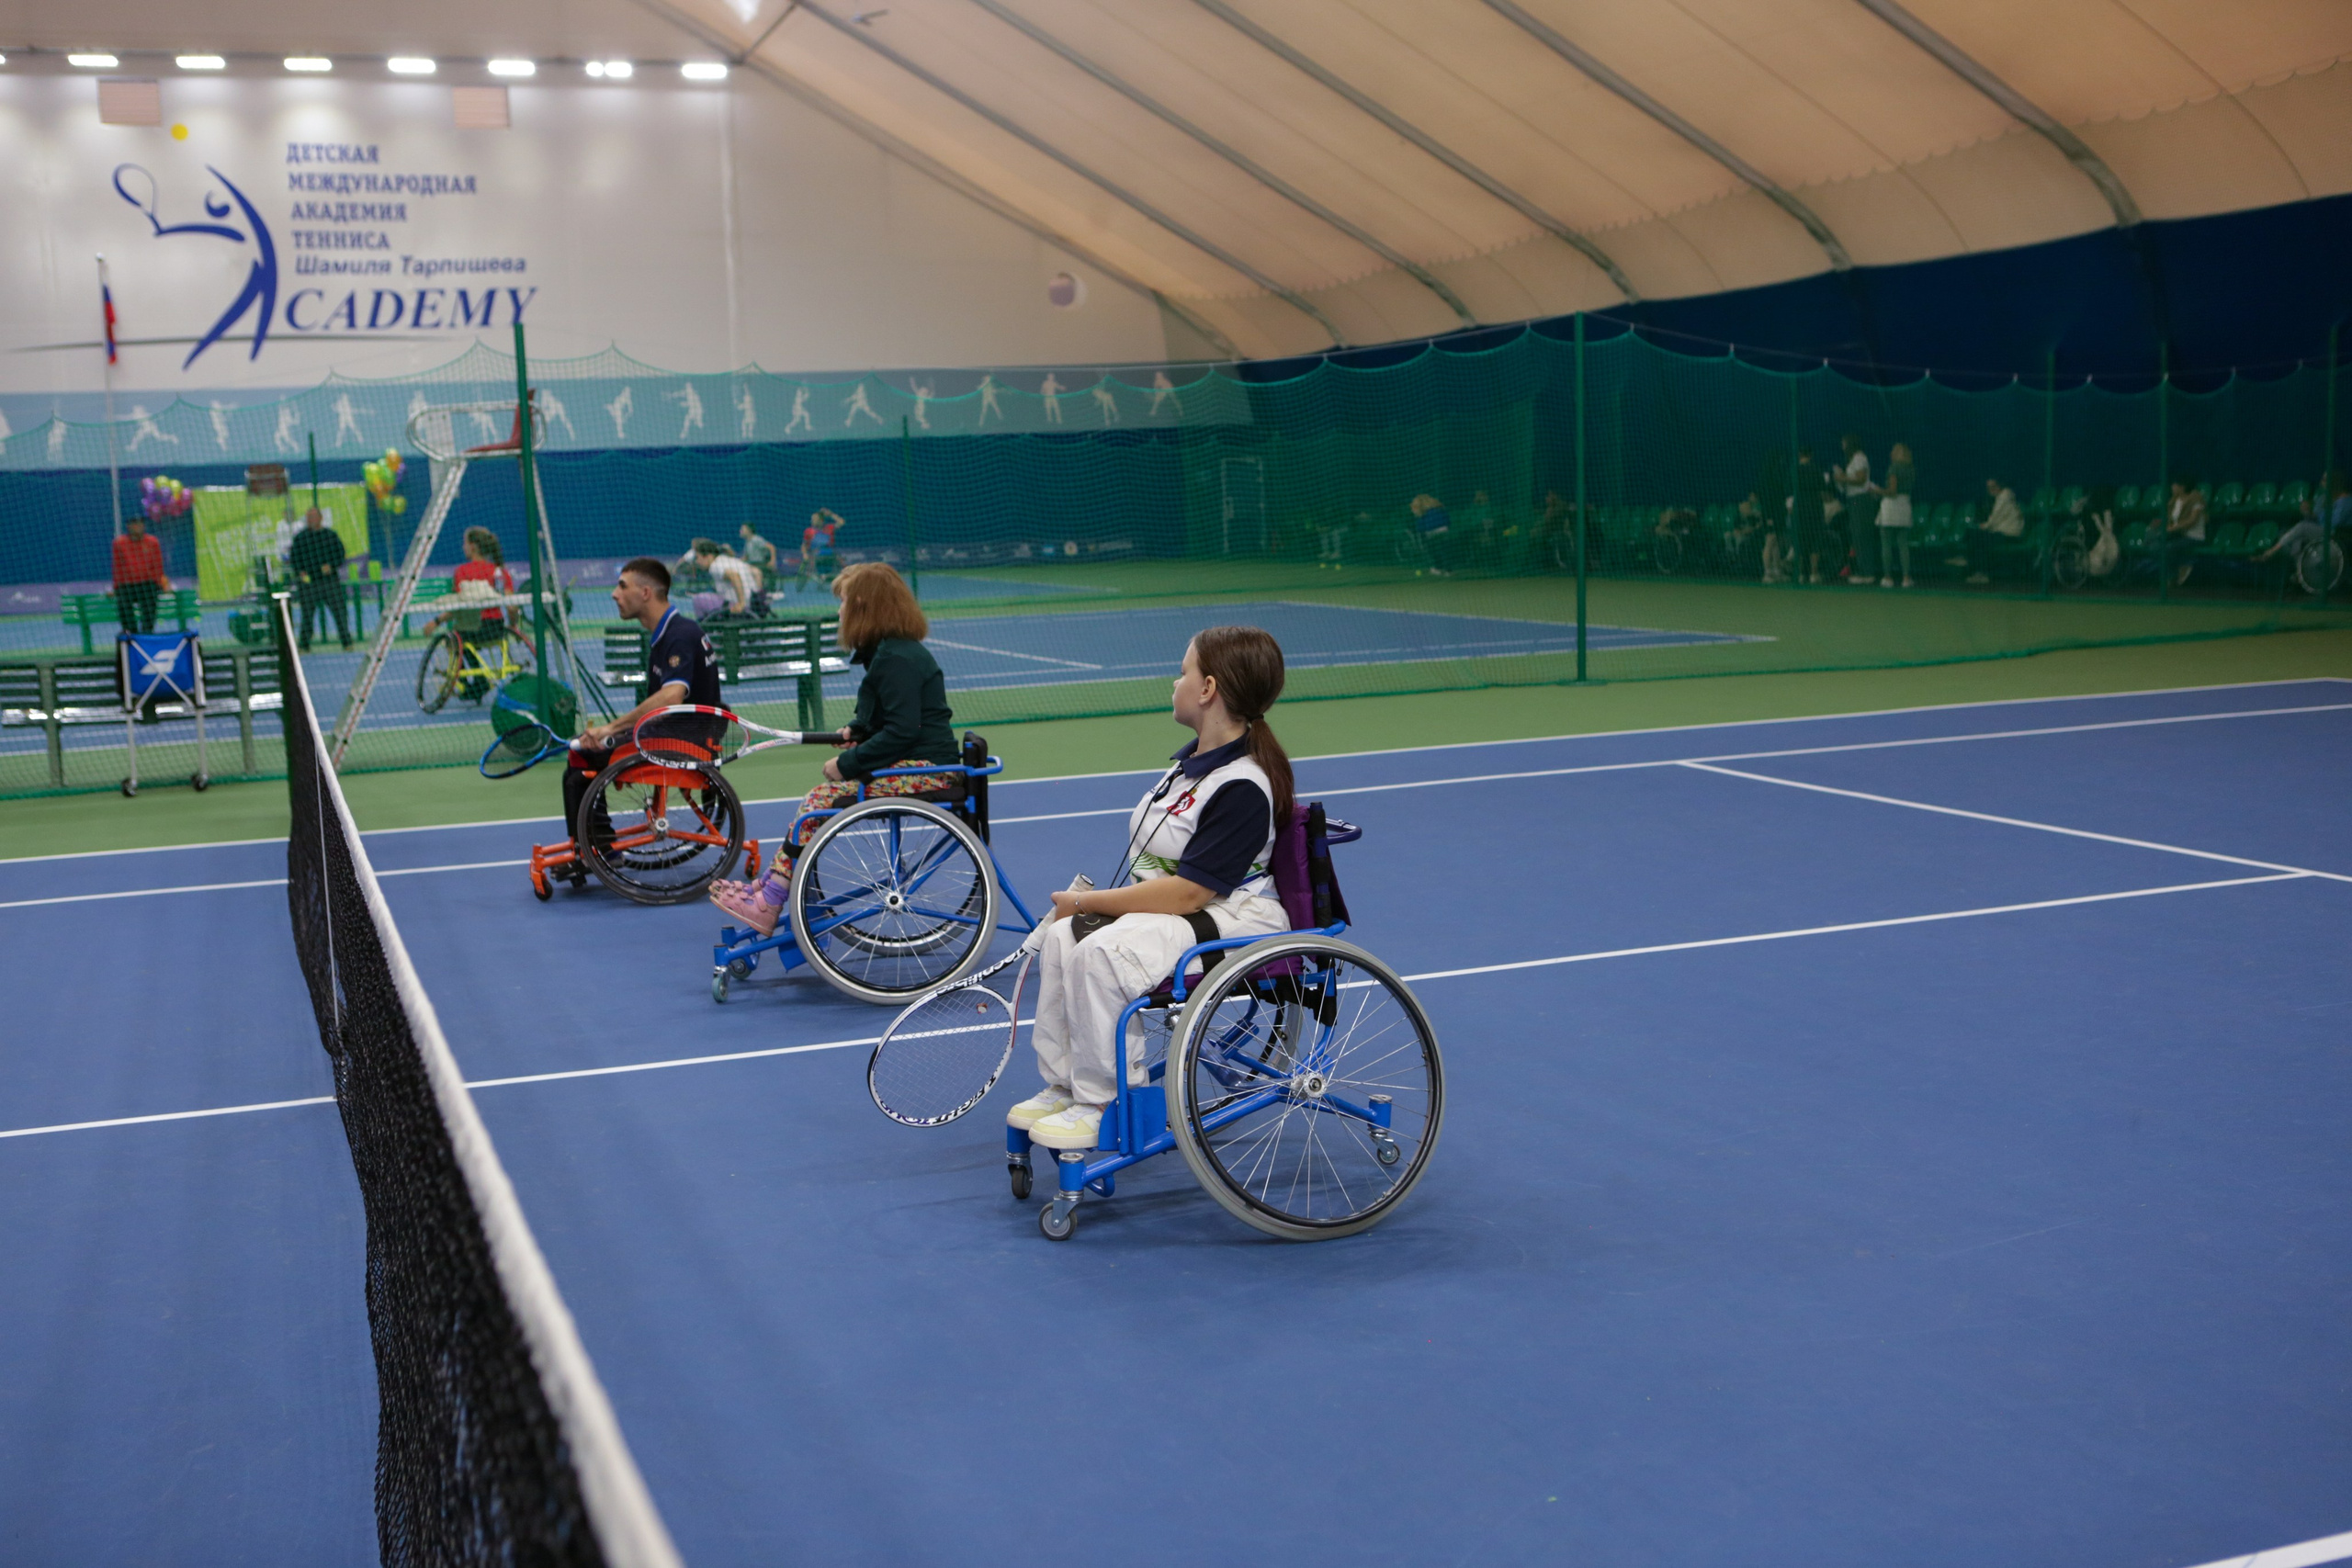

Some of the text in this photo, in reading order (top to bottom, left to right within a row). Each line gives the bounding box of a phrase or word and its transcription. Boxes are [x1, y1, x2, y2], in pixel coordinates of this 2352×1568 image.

[286, 142, 379, 164] ДЕТСКАЯ
[288, 173, 477, 196] МЕЖДУНАРОДНАЯ
[291, 202, 407, 223] АКАДЕМИЯ
[291, 230, 390, 250] ТЕННИСА
[295, 254, 526, 278] Шамиля Тарпишева
[936, 949, 1025, 994] Tecnifibre
